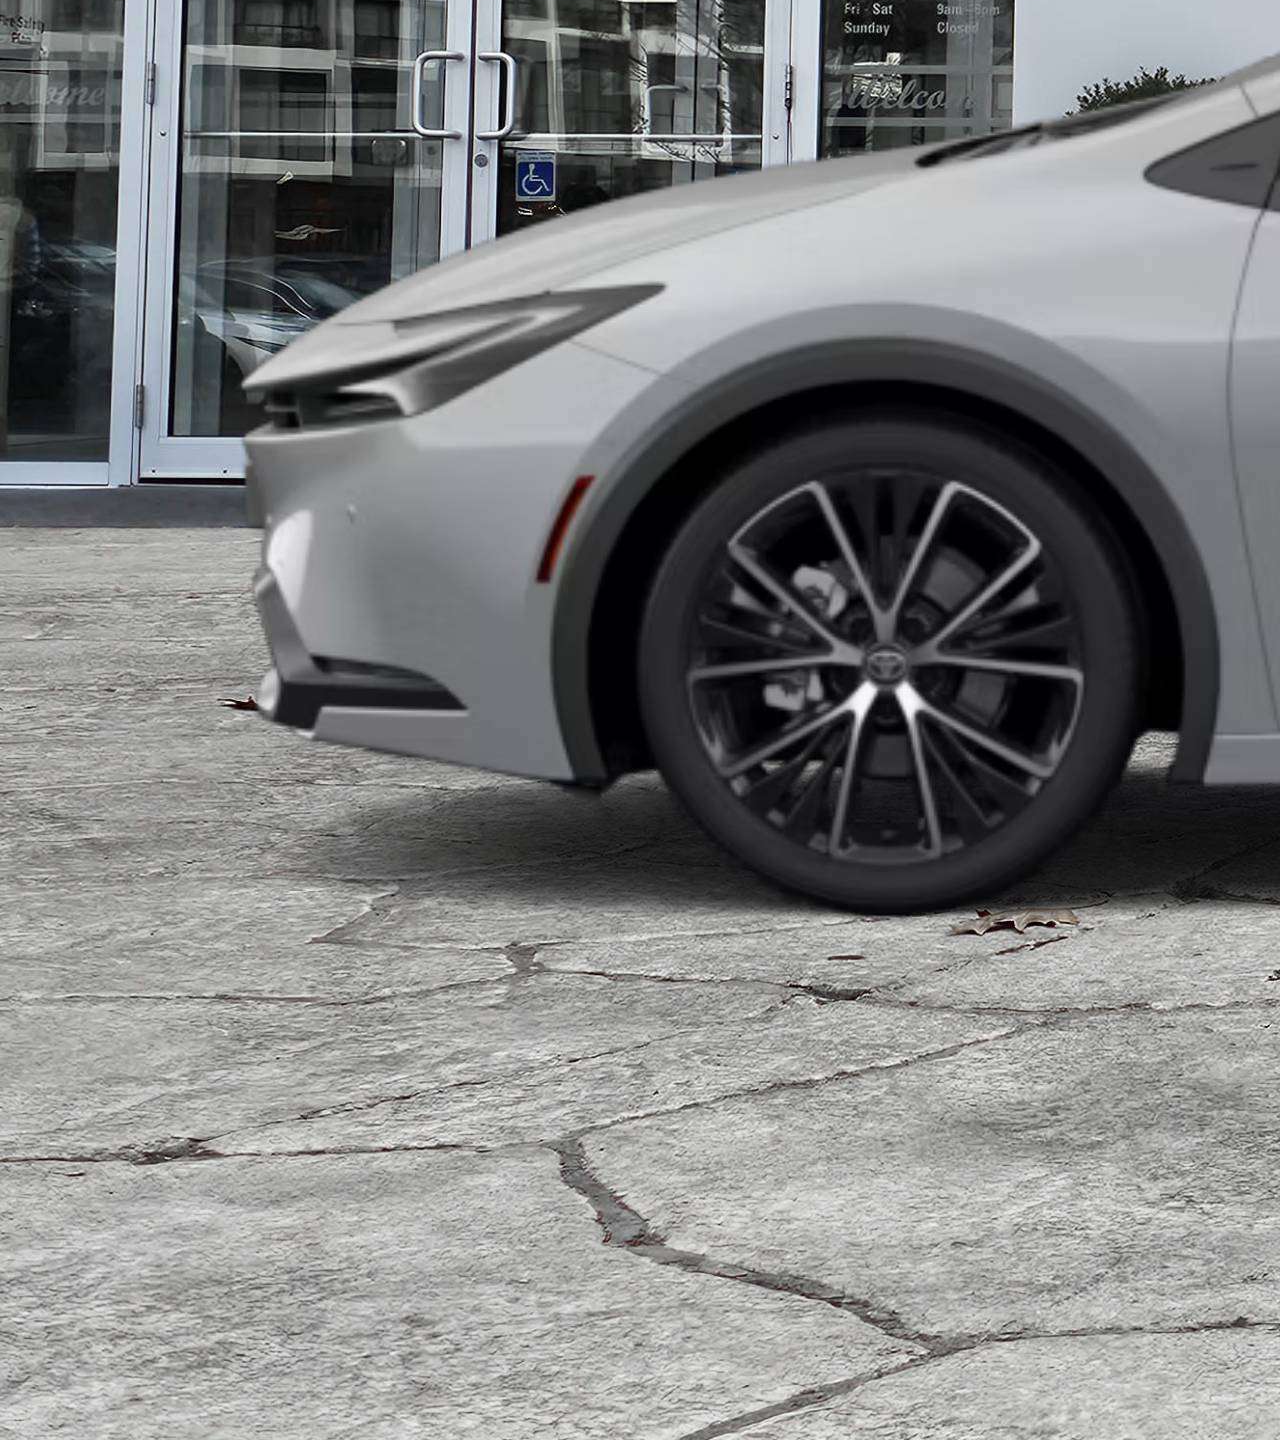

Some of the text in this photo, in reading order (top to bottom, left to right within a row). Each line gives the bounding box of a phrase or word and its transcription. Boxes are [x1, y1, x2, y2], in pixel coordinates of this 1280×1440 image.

[844, 3, 861, 15] Fri
[872, 2, 895, 15] Sat
[844, 21, 980, 37] Sunday Closed
